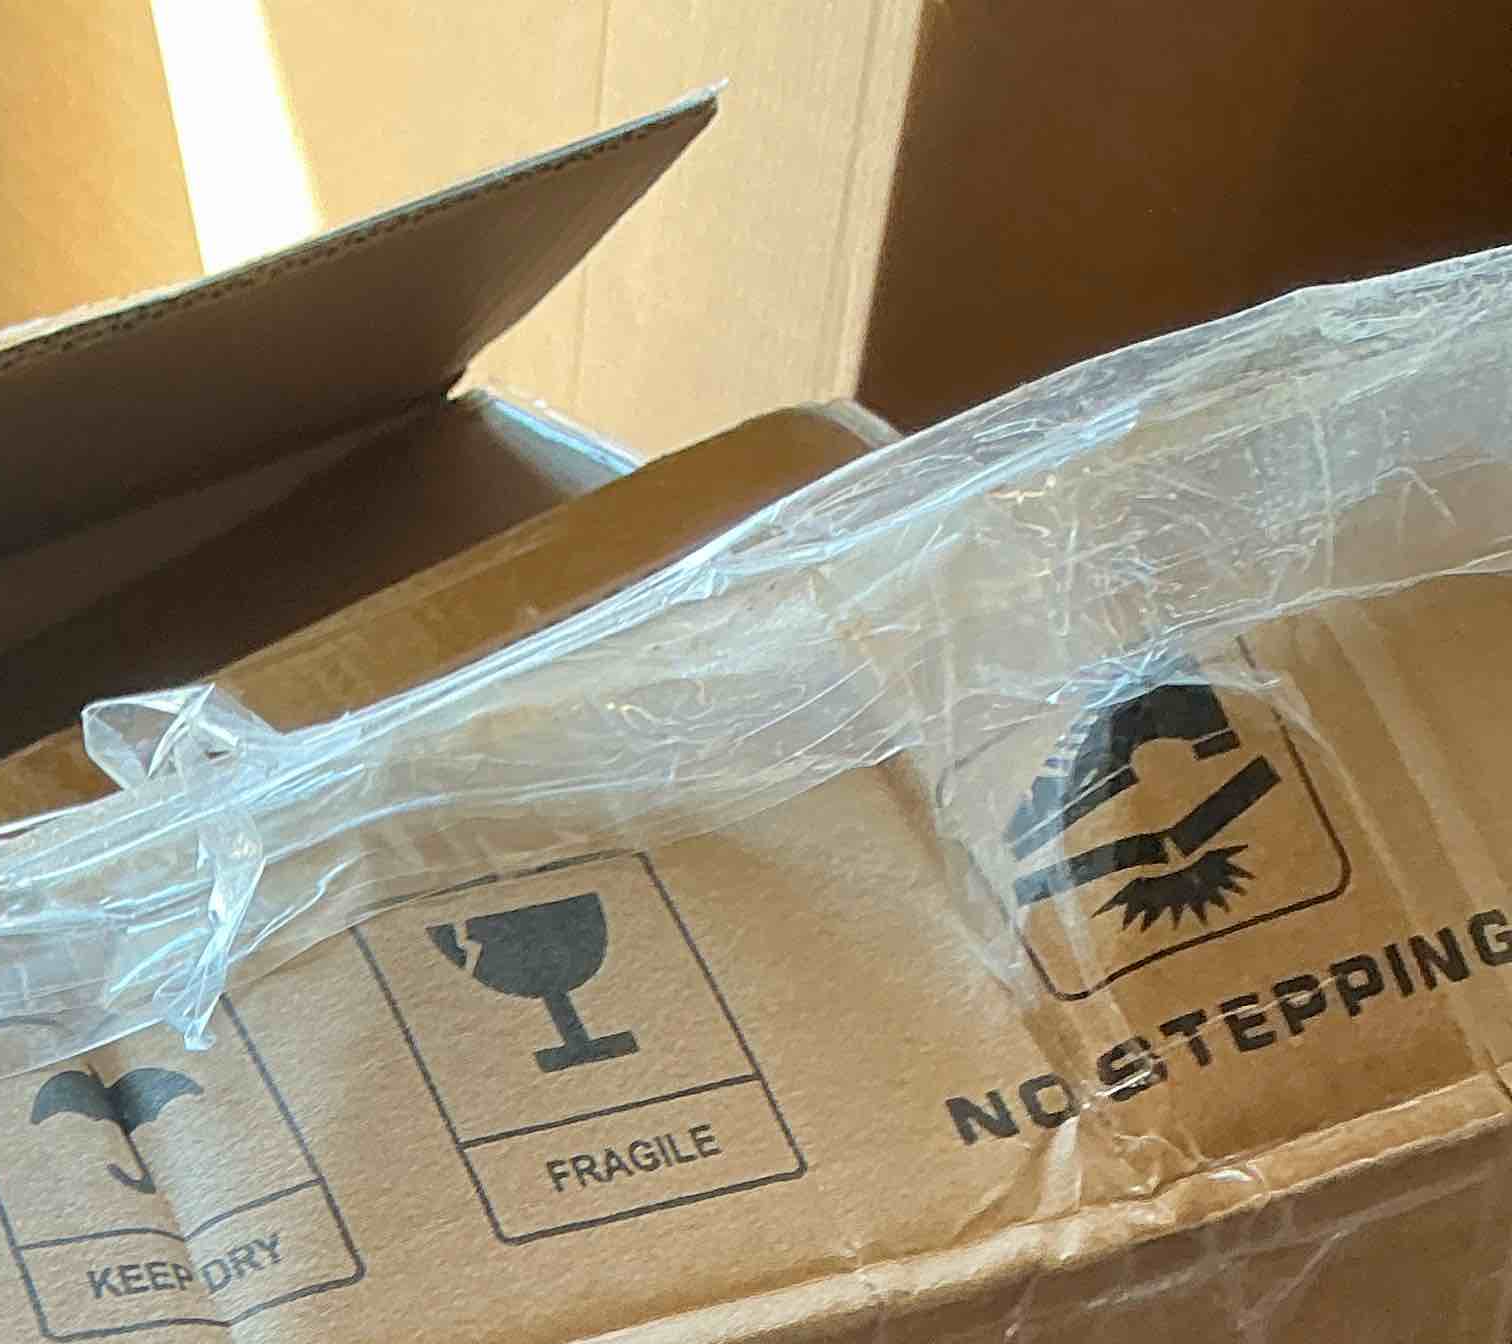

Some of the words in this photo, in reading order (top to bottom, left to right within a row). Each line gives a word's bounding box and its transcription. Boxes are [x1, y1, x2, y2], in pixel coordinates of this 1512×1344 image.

[944, 1073, 1081, 1146] NO
[1095, 909, 1512, 1103] STEPPING
[546, 1124, 722, 1194] FRAGILE
[86, 1262, 195, 1300] KEEP
[200, 1234, 284, 1293] DRY
